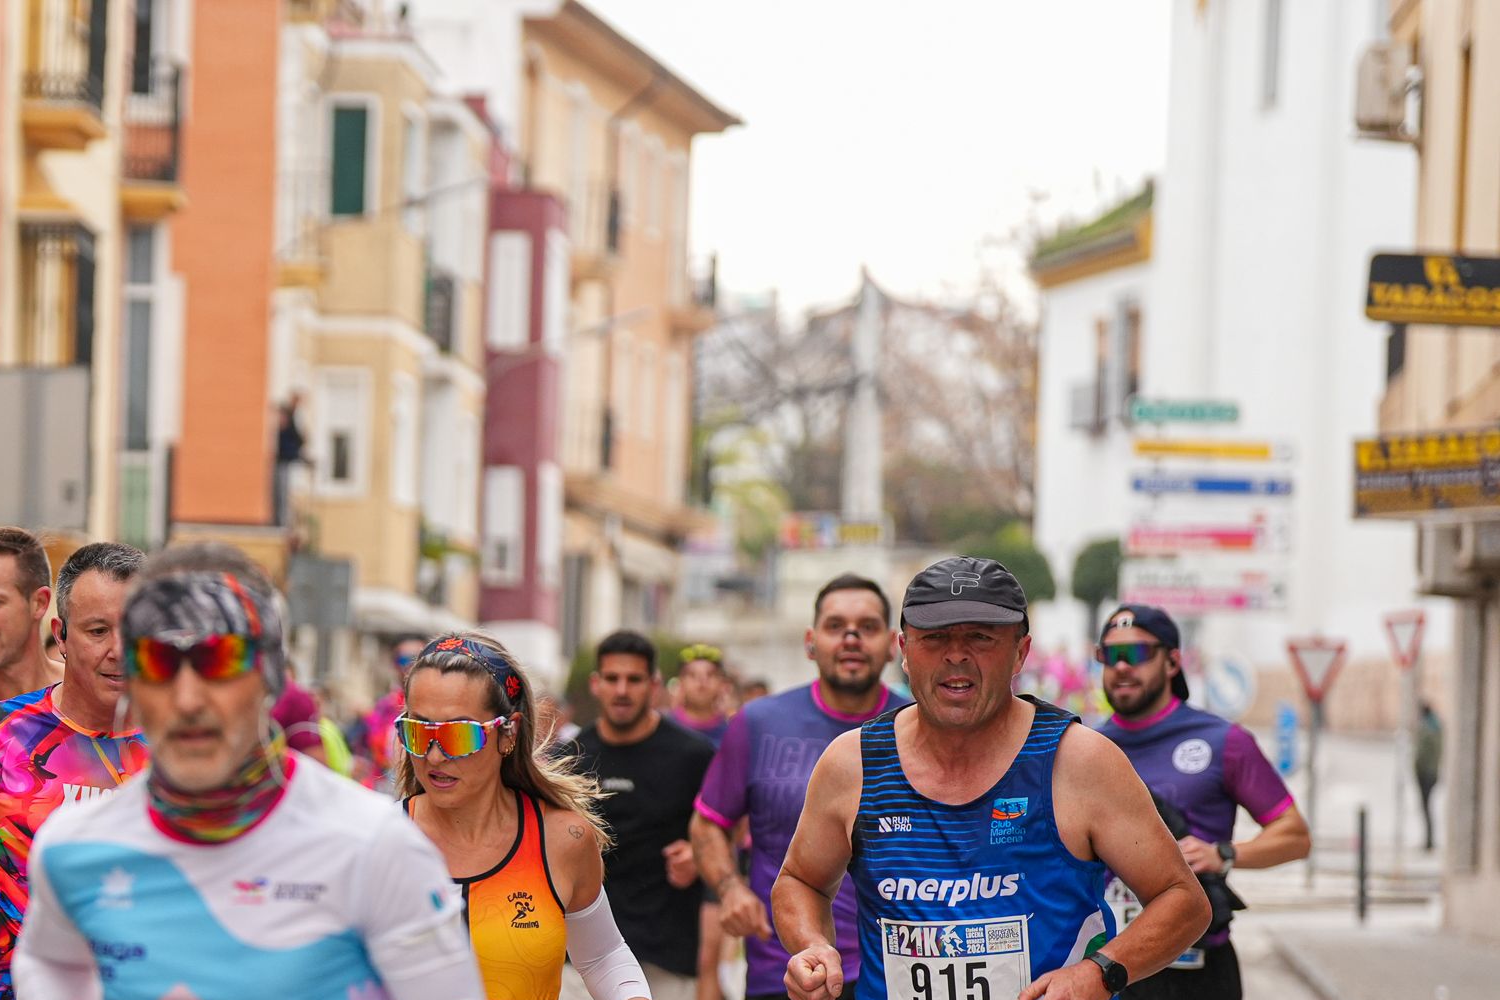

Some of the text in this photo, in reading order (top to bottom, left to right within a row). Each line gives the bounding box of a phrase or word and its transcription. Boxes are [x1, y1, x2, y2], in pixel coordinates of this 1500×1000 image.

[892, 816, 910, 824] RUN
[990, 820, 1012, 828] Club
[894, 824, 912, 832] PRO
[991, 827, 1026, 837] Maratón
[990, 836, 1023, 845] Lucena
[877, 873, 1019, 907] enerplus
[507, 892, 533, 902] CABRA
[511, 920, 539, 928] running
[899, 925, 939, 957] 21K
[967, 943, 985, 954] 2026
